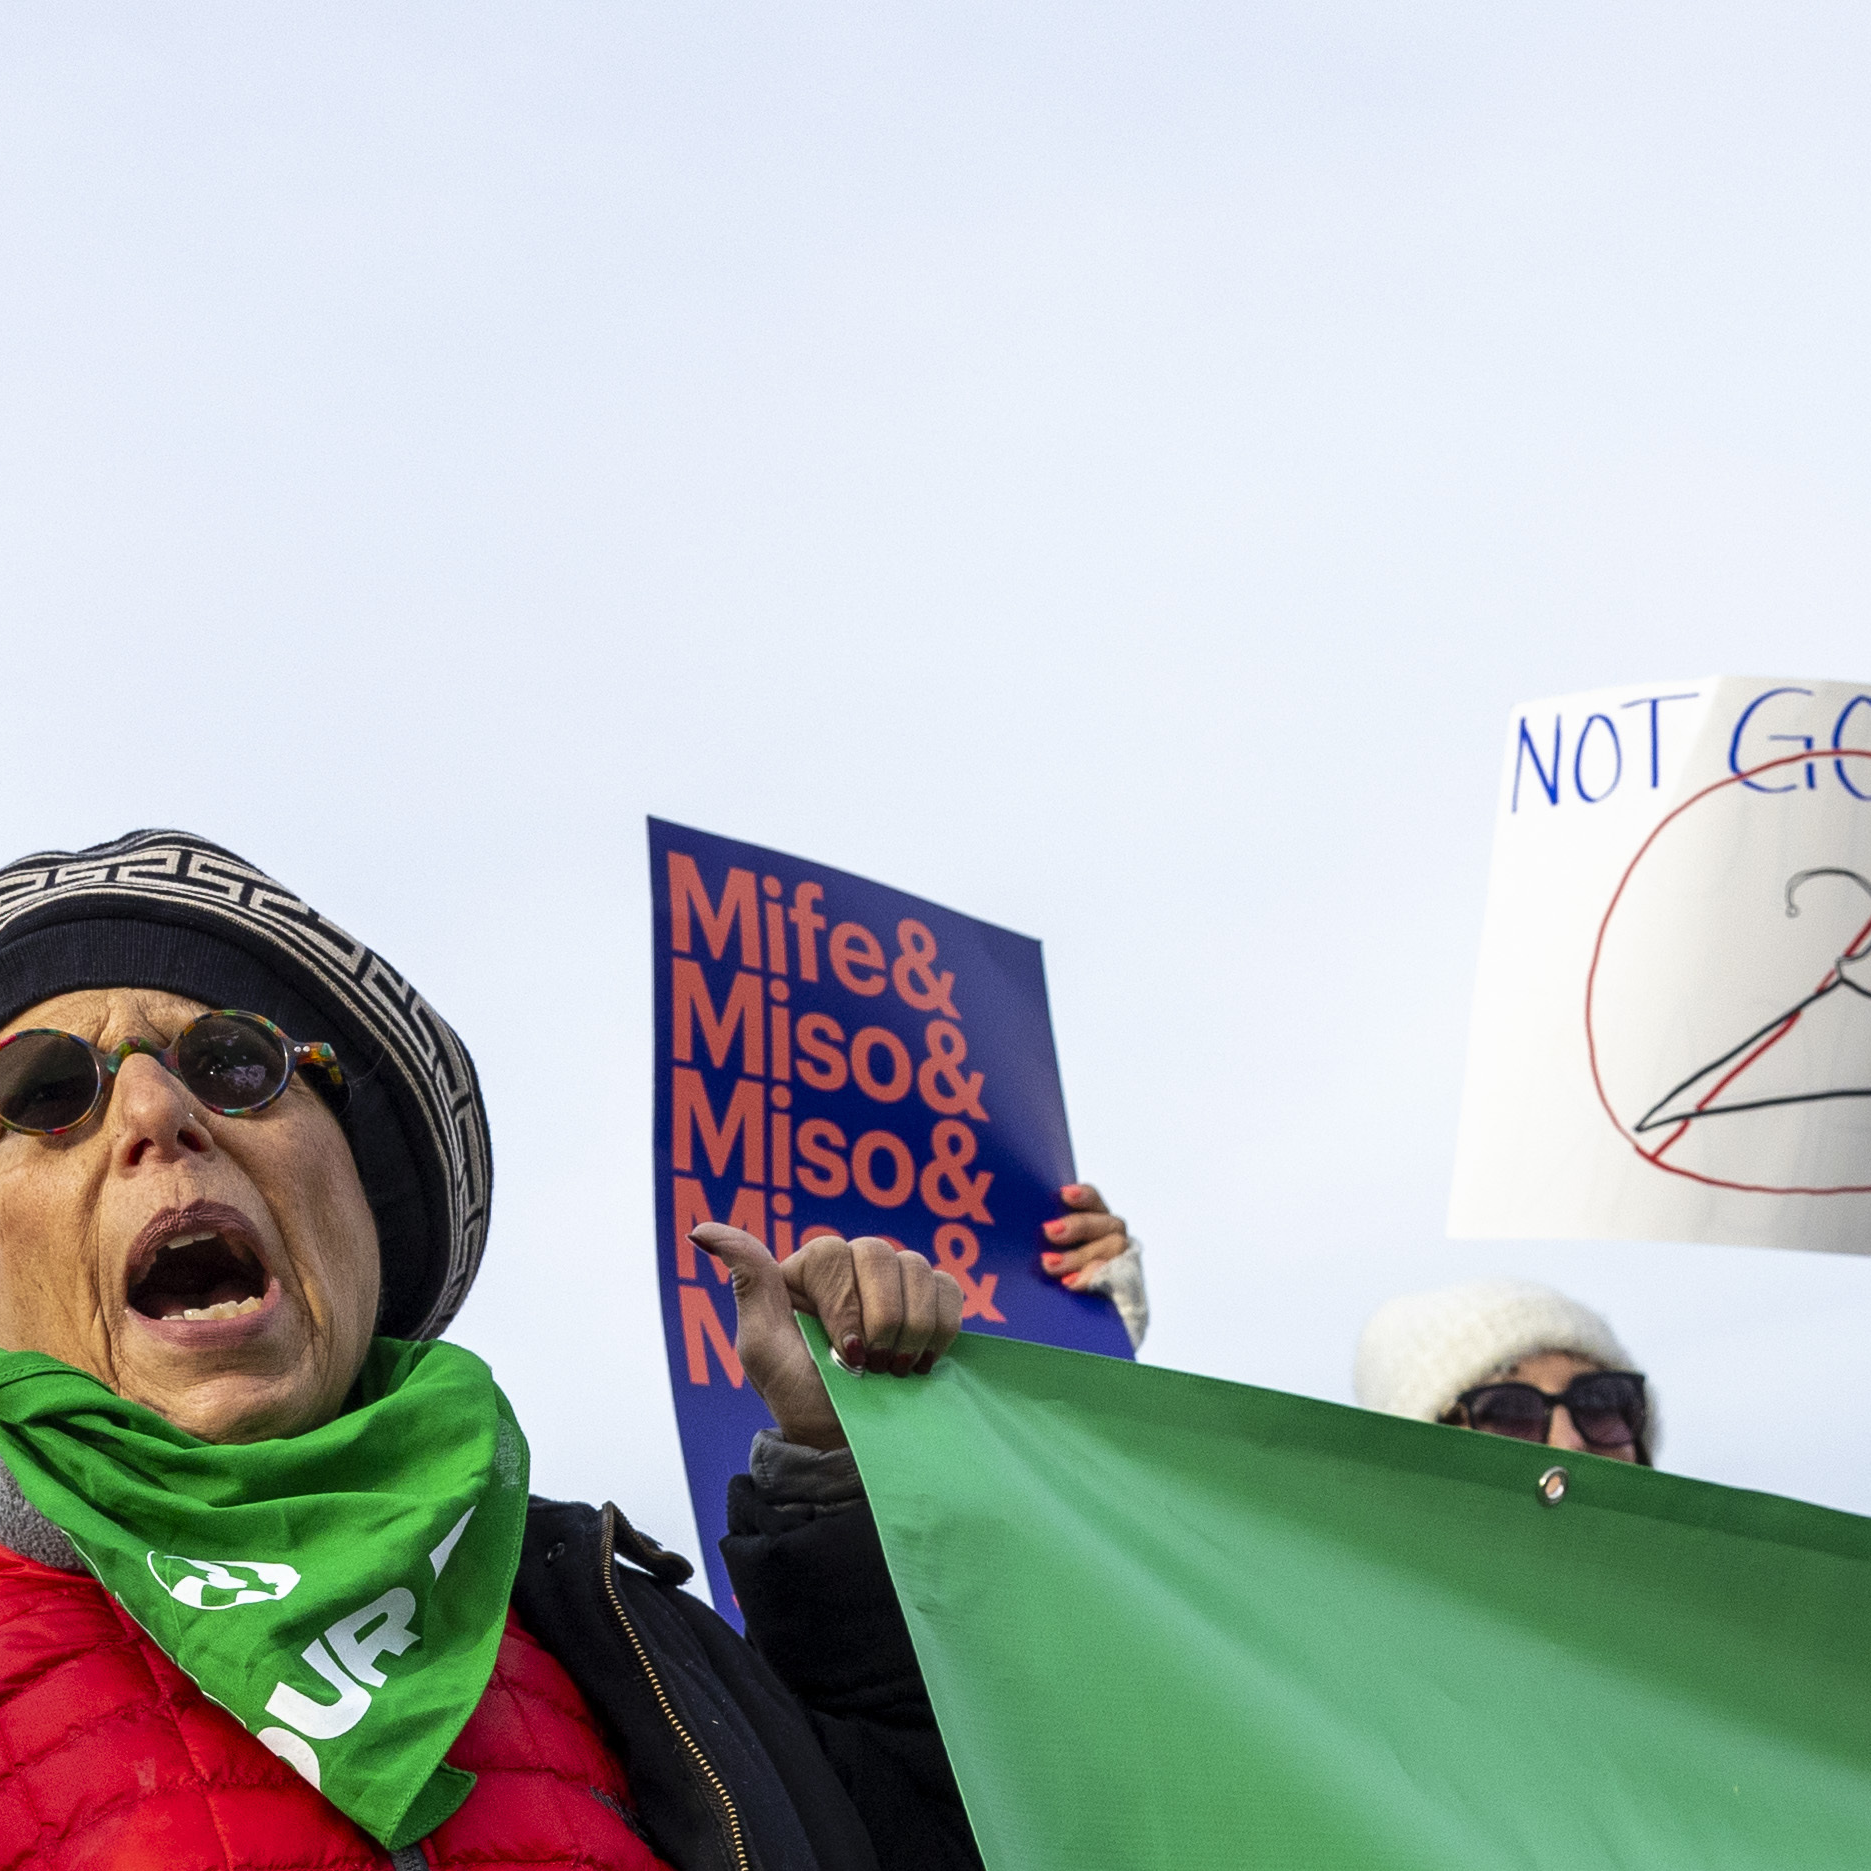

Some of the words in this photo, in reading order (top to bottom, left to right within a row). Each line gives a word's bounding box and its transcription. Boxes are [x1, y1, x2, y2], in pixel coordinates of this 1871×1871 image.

[1511, 692, 1700, 814] NOT
[666, 850, 963, 1020] Mife&
[671, 957, 990, 1122] Miso&
[671, 1066, 995, 1226] Miso&
[674, 1176, 1007, 1323] Mi&
